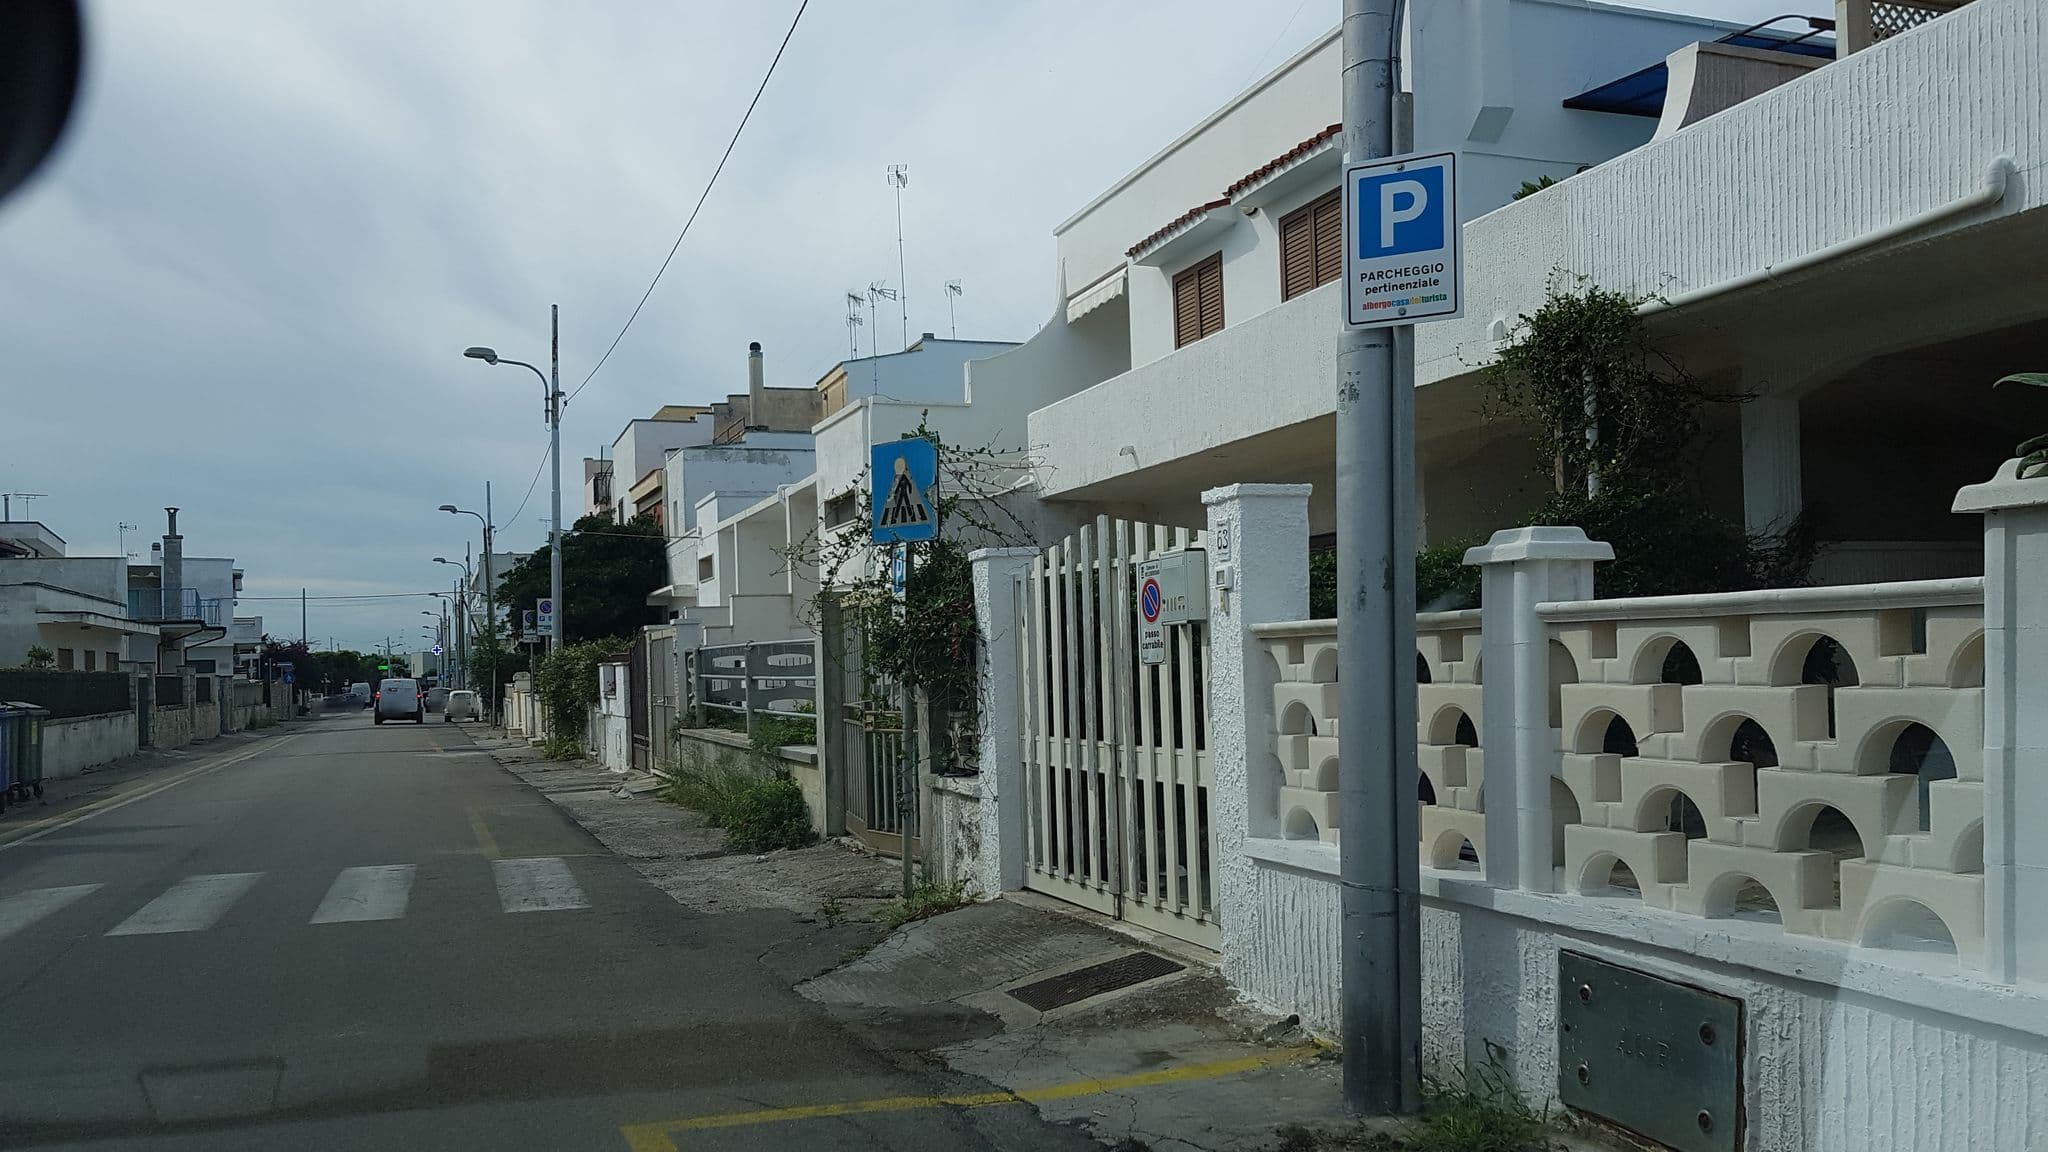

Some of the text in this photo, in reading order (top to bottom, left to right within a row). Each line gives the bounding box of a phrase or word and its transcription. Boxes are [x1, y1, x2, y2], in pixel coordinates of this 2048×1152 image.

[1380, 179, 1428, 249] P
[1360, 262, 1444, 283] PARCHEGGIO
[1365, 277, 1440, 296] pertinenziale
[1217, 529, 1229, 550] 63
[1142, 639, 1164, 650] carrabile
[1145, 630, 1160, 640] passo
